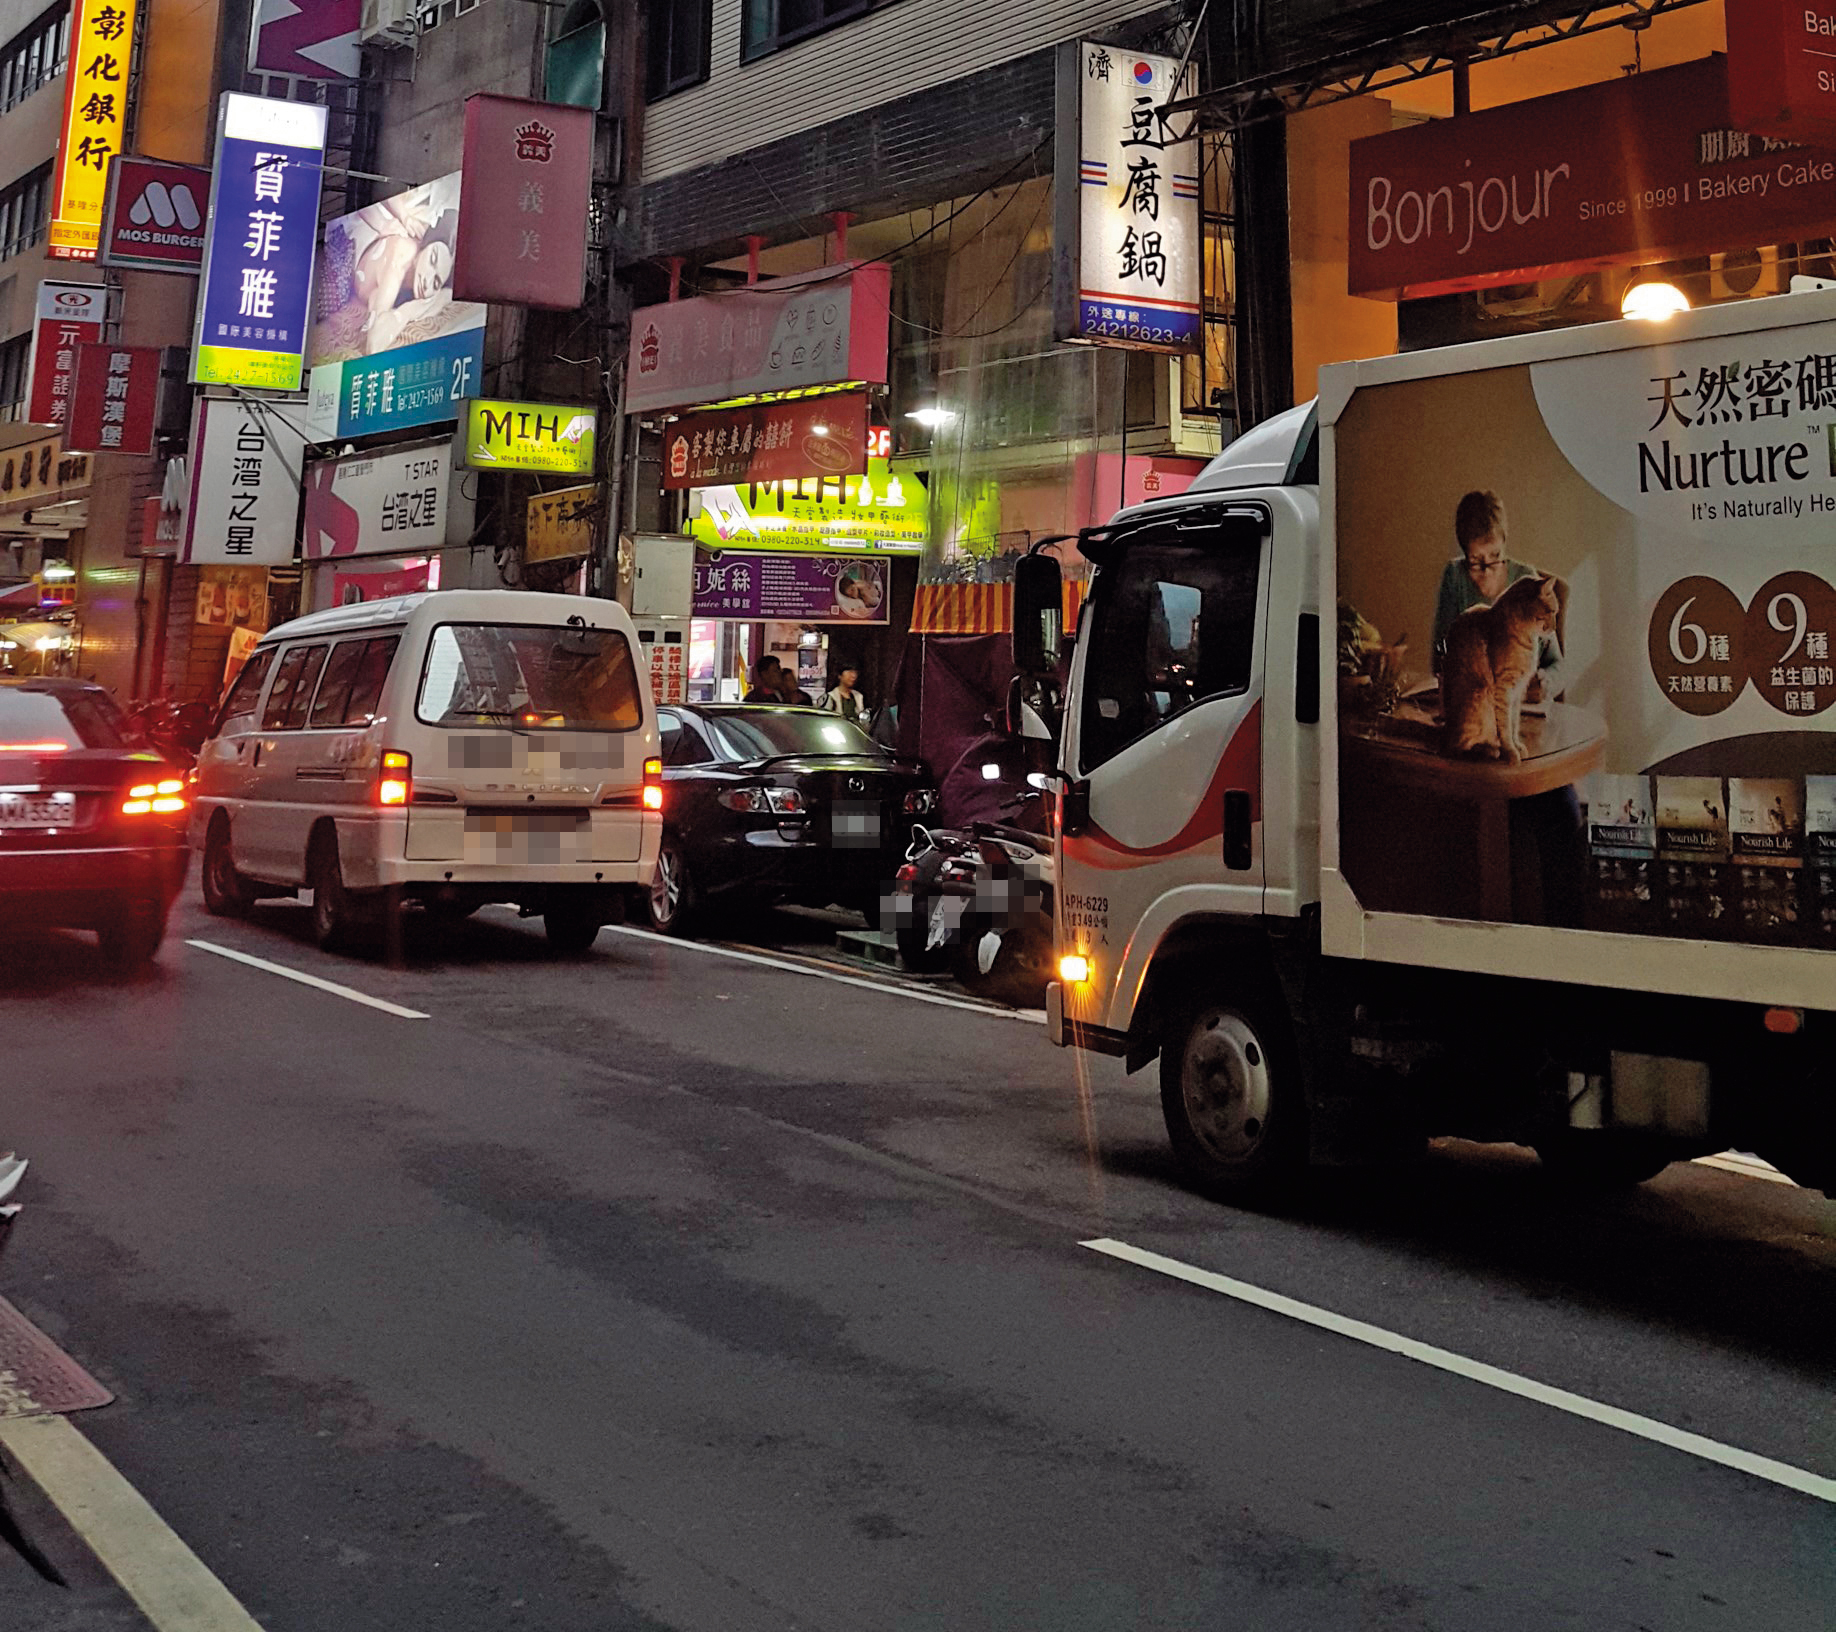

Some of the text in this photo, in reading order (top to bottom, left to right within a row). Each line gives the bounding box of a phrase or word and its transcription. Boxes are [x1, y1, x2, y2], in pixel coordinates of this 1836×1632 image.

[1088, 49, 1114, 83] 濟
[75, 5, 127, 172] 彰化銀行
[1118, 96, 1166, 288] 豆腐鍋
[1367, 159, 1570, 255] Bonjour
[1579, 197, 1626, 221] Since
[1635, 186, 1677, 211] 1999
[1699, 171, 1770, 201] Bakery
[1778, 159, 1835, 187] Cake
[118, 228, 151, 243] MOS
[518, 181, 544, 263] 義美
[1086, 319, 1192, 344] 24212623-4
[50, 324, 80, 421] 元富證券
[450, 356, 473, 400] 2F
[101, 353, 132, 447] 摩斯漢堡
[1647, 354, 1836, 432] 天然密碼
[480, 409, 559, 447] MIH
[405, 459, 439, 480] T STAR
[1638, 440, 1810, 493] Nurture
[749, 474, 846, 512] MIH
[1692, 502, 1717, 520] It's
[1724, 496, 1803, 519] Naturally
[761, 535, 821, 547] 0980-220-314
[1669, 596, 1730, 664] 6種
[1767, 592, 1828, 663] 9種
[1668, 676, 1733, 692] 天然營養素
[1770, 666, 1833, 686] 益生菌的
[1785, 691, 1815, 710] 保護
[1667, 831, 1699, 845] Nourish
[1740, 835, 1774, 848] Nourish
[1066, 894, 1108, 912] APH-6229
